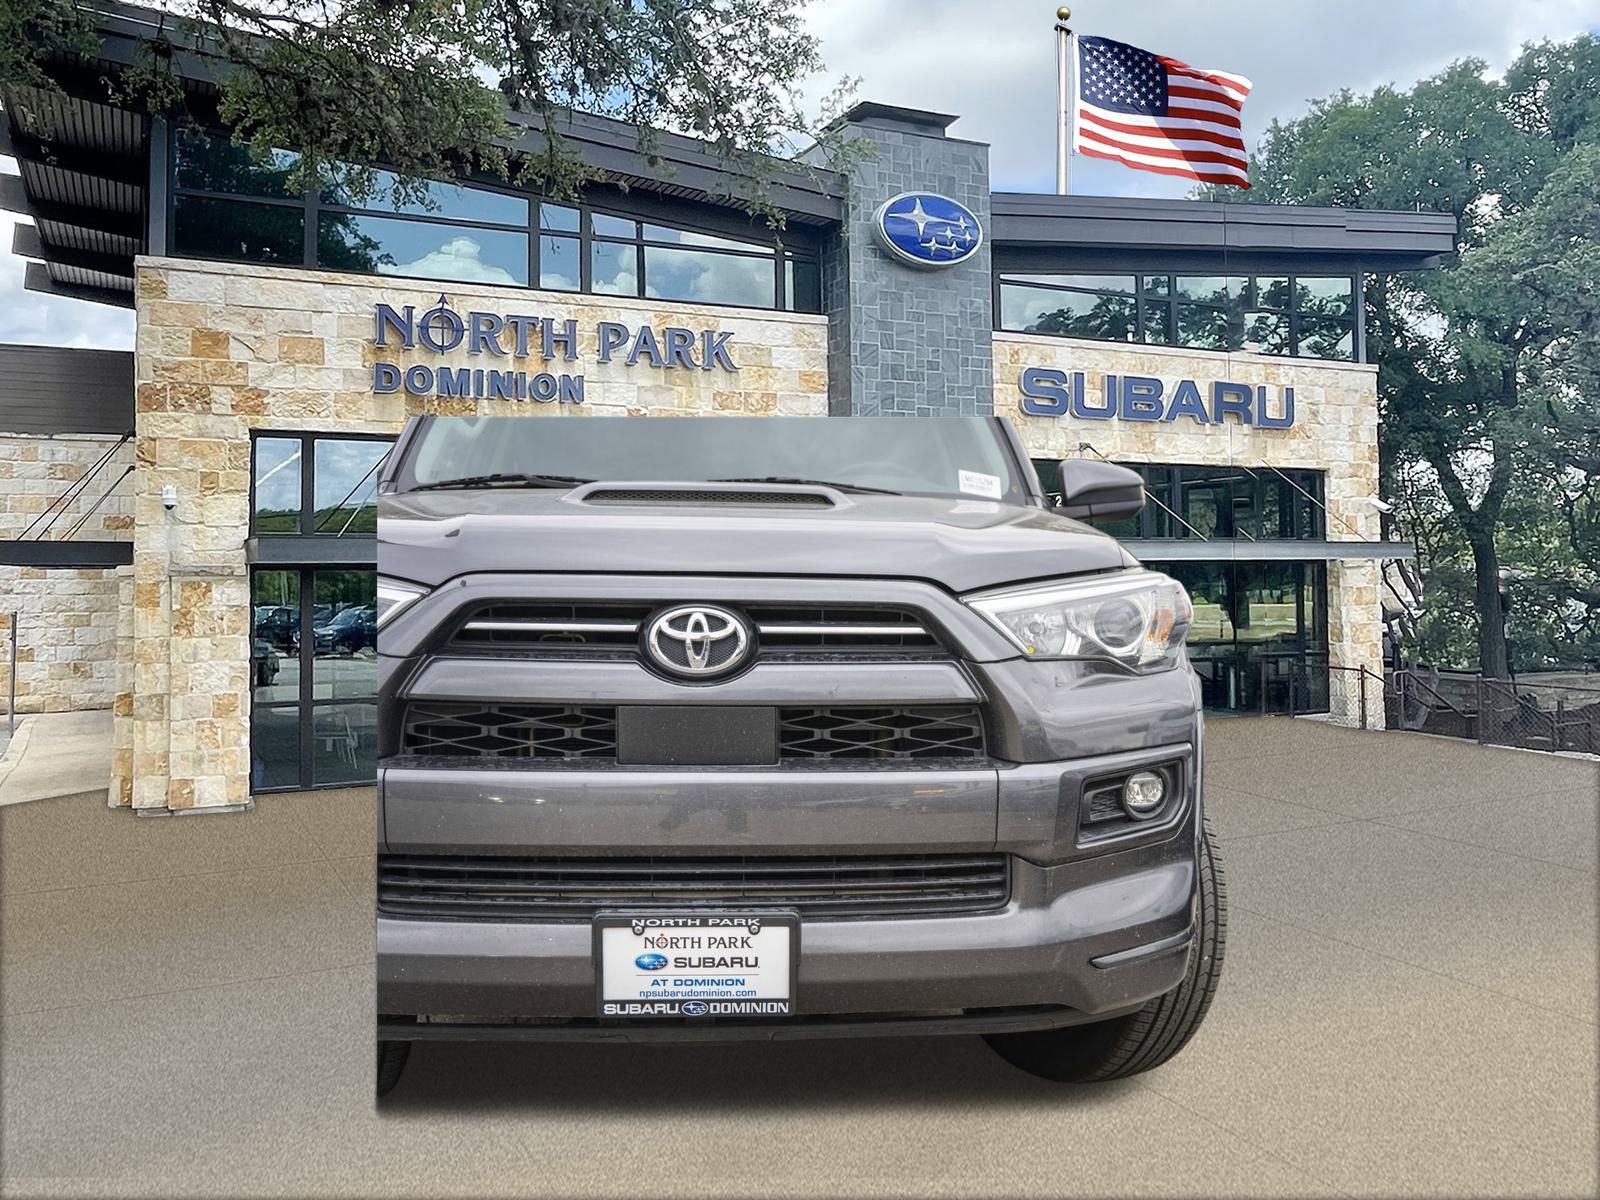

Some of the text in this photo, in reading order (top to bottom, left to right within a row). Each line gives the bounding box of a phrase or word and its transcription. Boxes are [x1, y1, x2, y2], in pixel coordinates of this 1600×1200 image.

[374, 292, 740, 373] NORTH PARK
[373, 362, 585, 405] DOMINION
[1019, 367, 1295, 429] SUBARU
[708, 918, 761, 926] PARK
[644, 934, 753, 949] NORTH PARK
[650, 978, 746, 987] AT DOMINION
[639, 988, 757, 998] npsubarudominion.com
[709, 1002, 789, 1014] DOMINION
